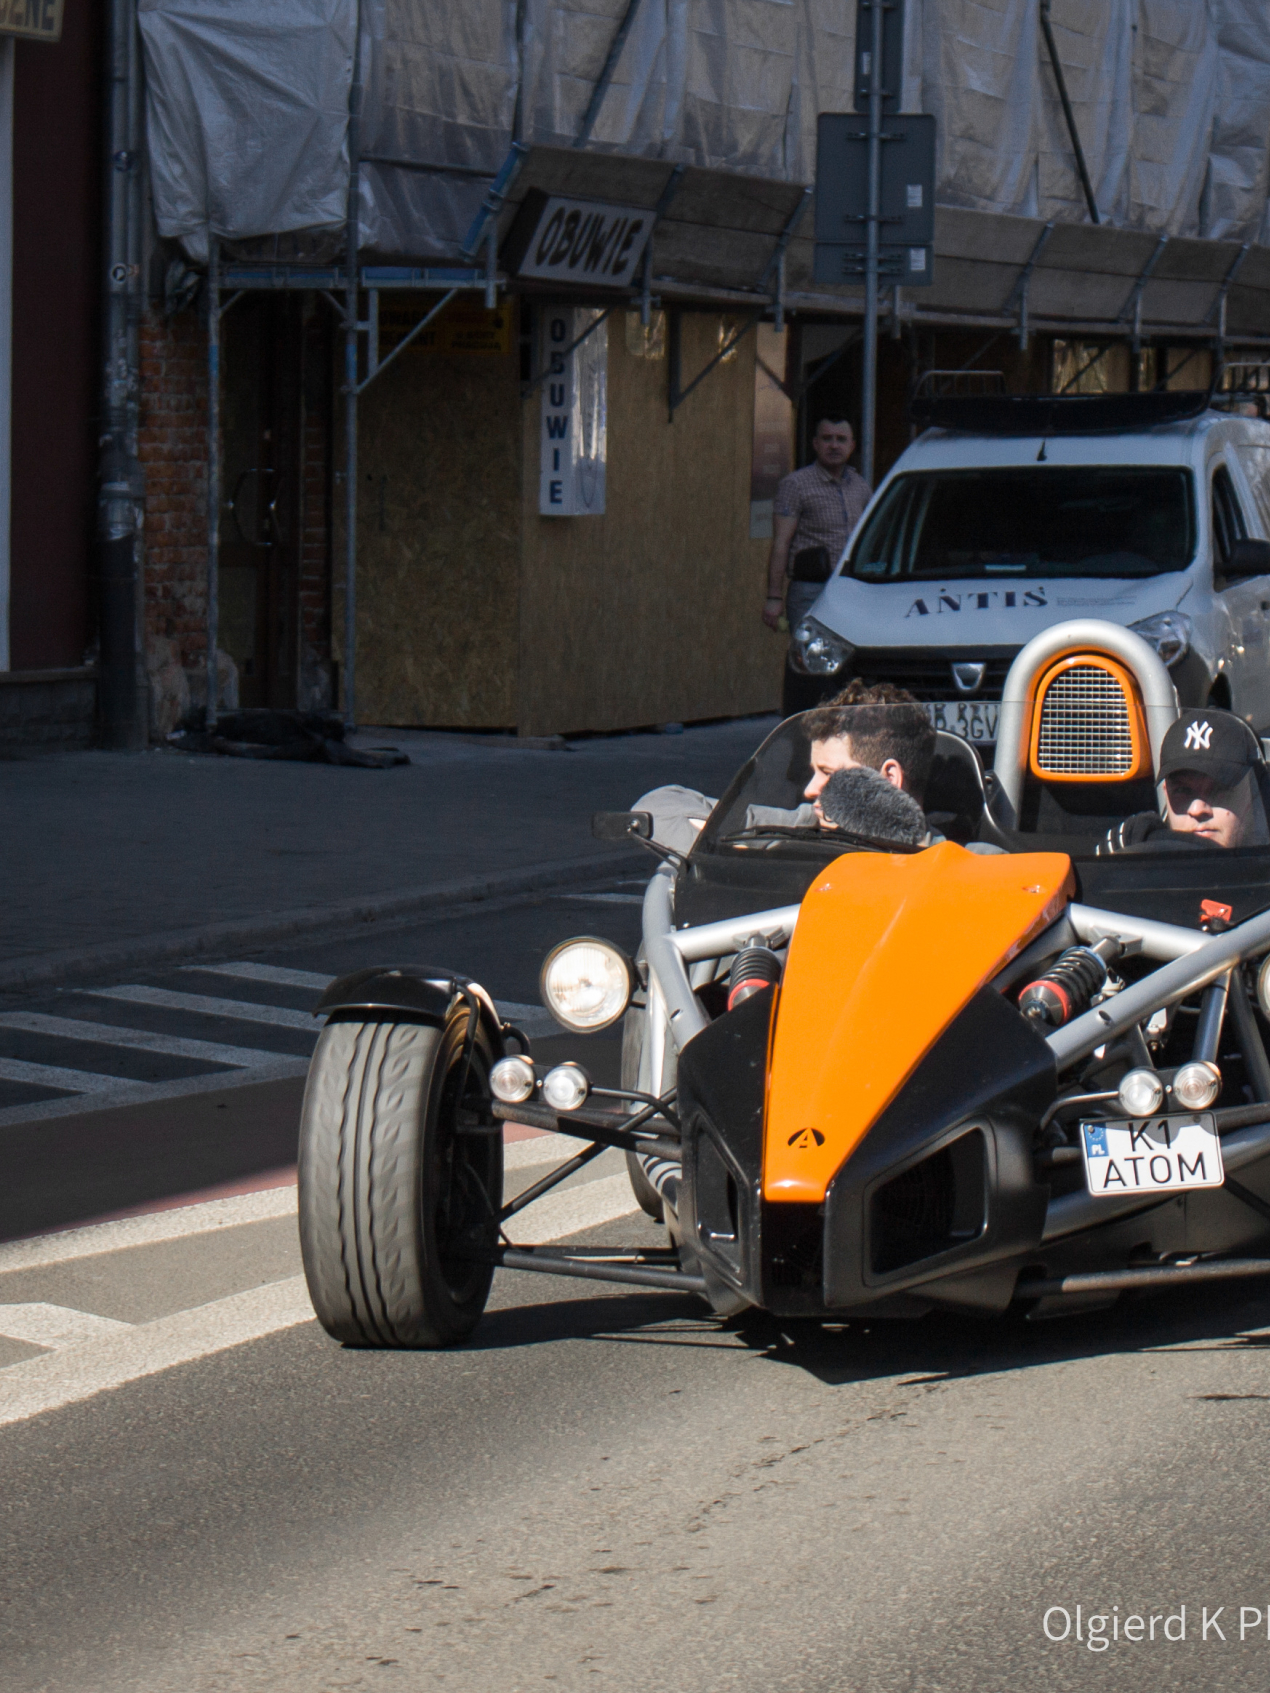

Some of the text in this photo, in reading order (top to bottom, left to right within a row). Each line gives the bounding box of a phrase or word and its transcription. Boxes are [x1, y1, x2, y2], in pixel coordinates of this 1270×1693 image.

[535, 206, 643, 275] OBUWIE
[546, 318, 568, 503] OBUWIE
[905, 586, 1049, 619] ANTIS
[1184, 720, 1214, 750] NY
[1091, 1144, 1105, 1155] PL
[1128, 1120, 1171, 1151] K1
[1103, 1152, 1207, 1188] ATOM
